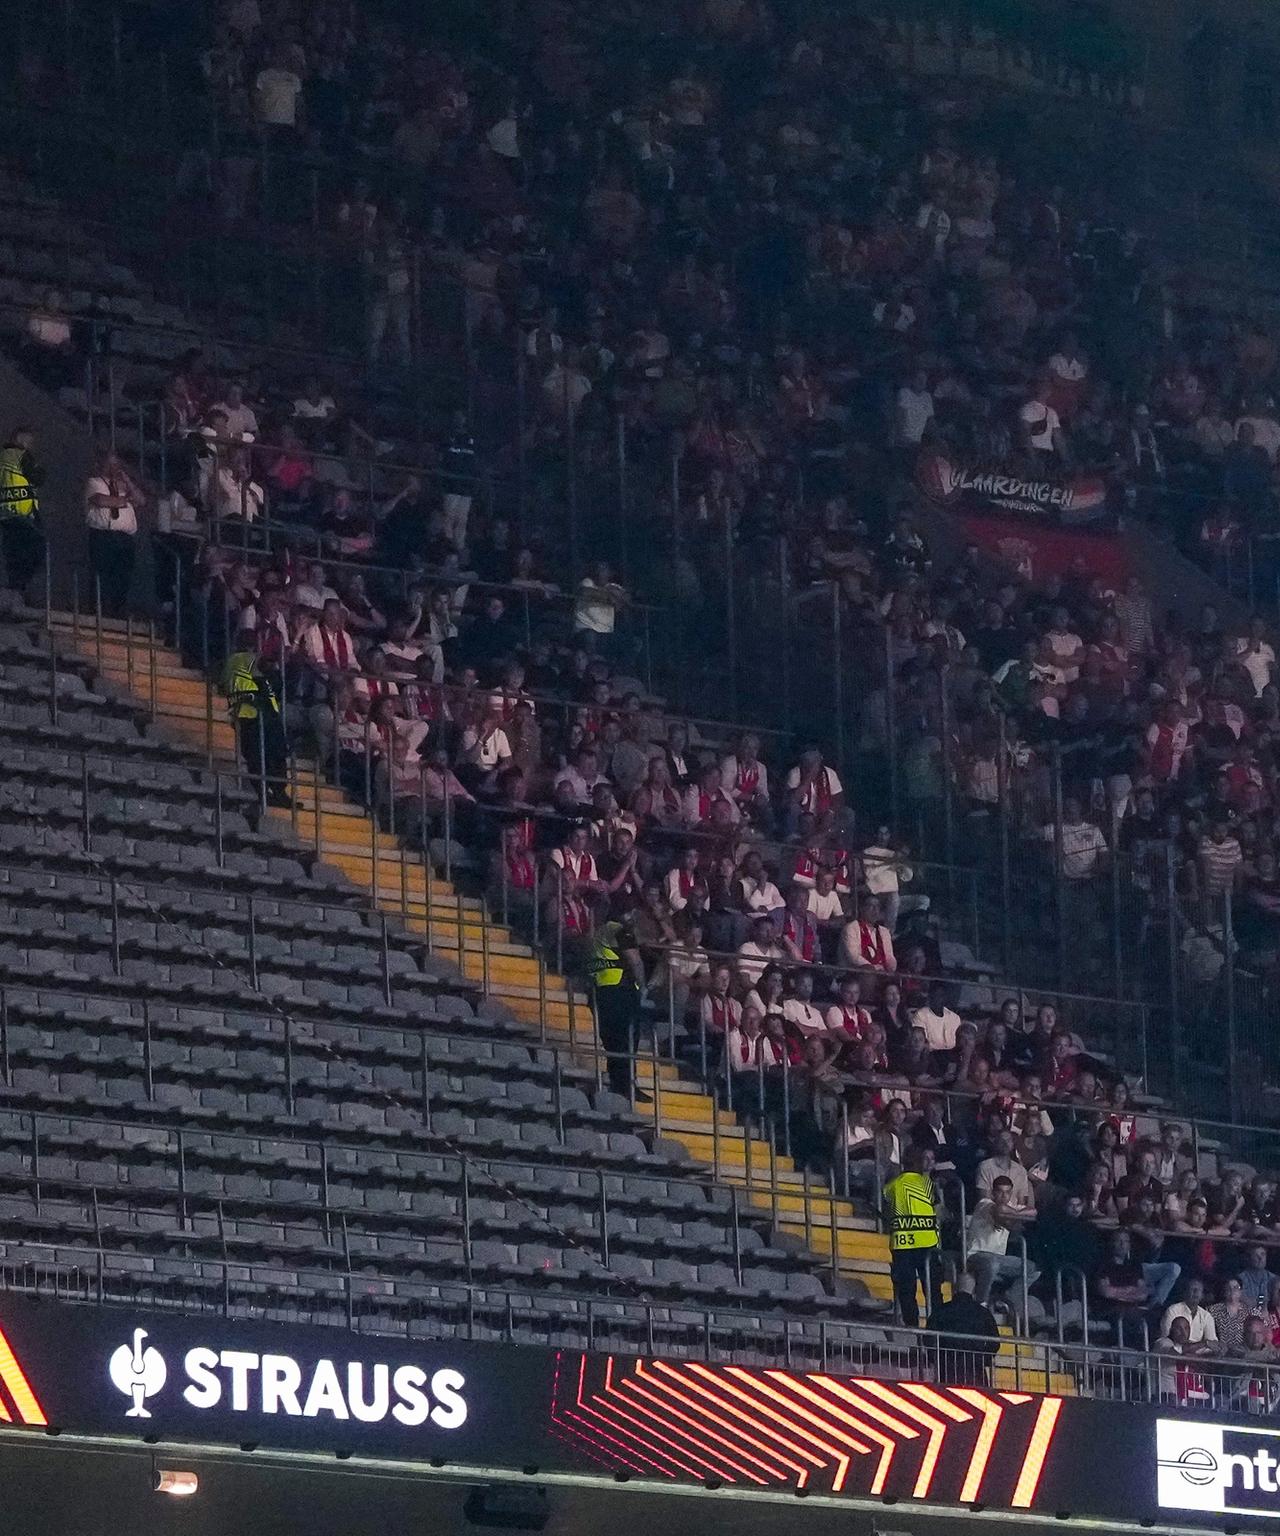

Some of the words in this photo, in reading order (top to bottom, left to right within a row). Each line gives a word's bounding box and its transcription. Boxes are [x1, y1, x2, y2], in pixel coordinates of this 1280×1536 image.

[949, 468, 1074, 507] VLAARDINGEN
[895, 1234, 915, 1246] 183
[183, 1347, 469, 1430] STRAUSS
